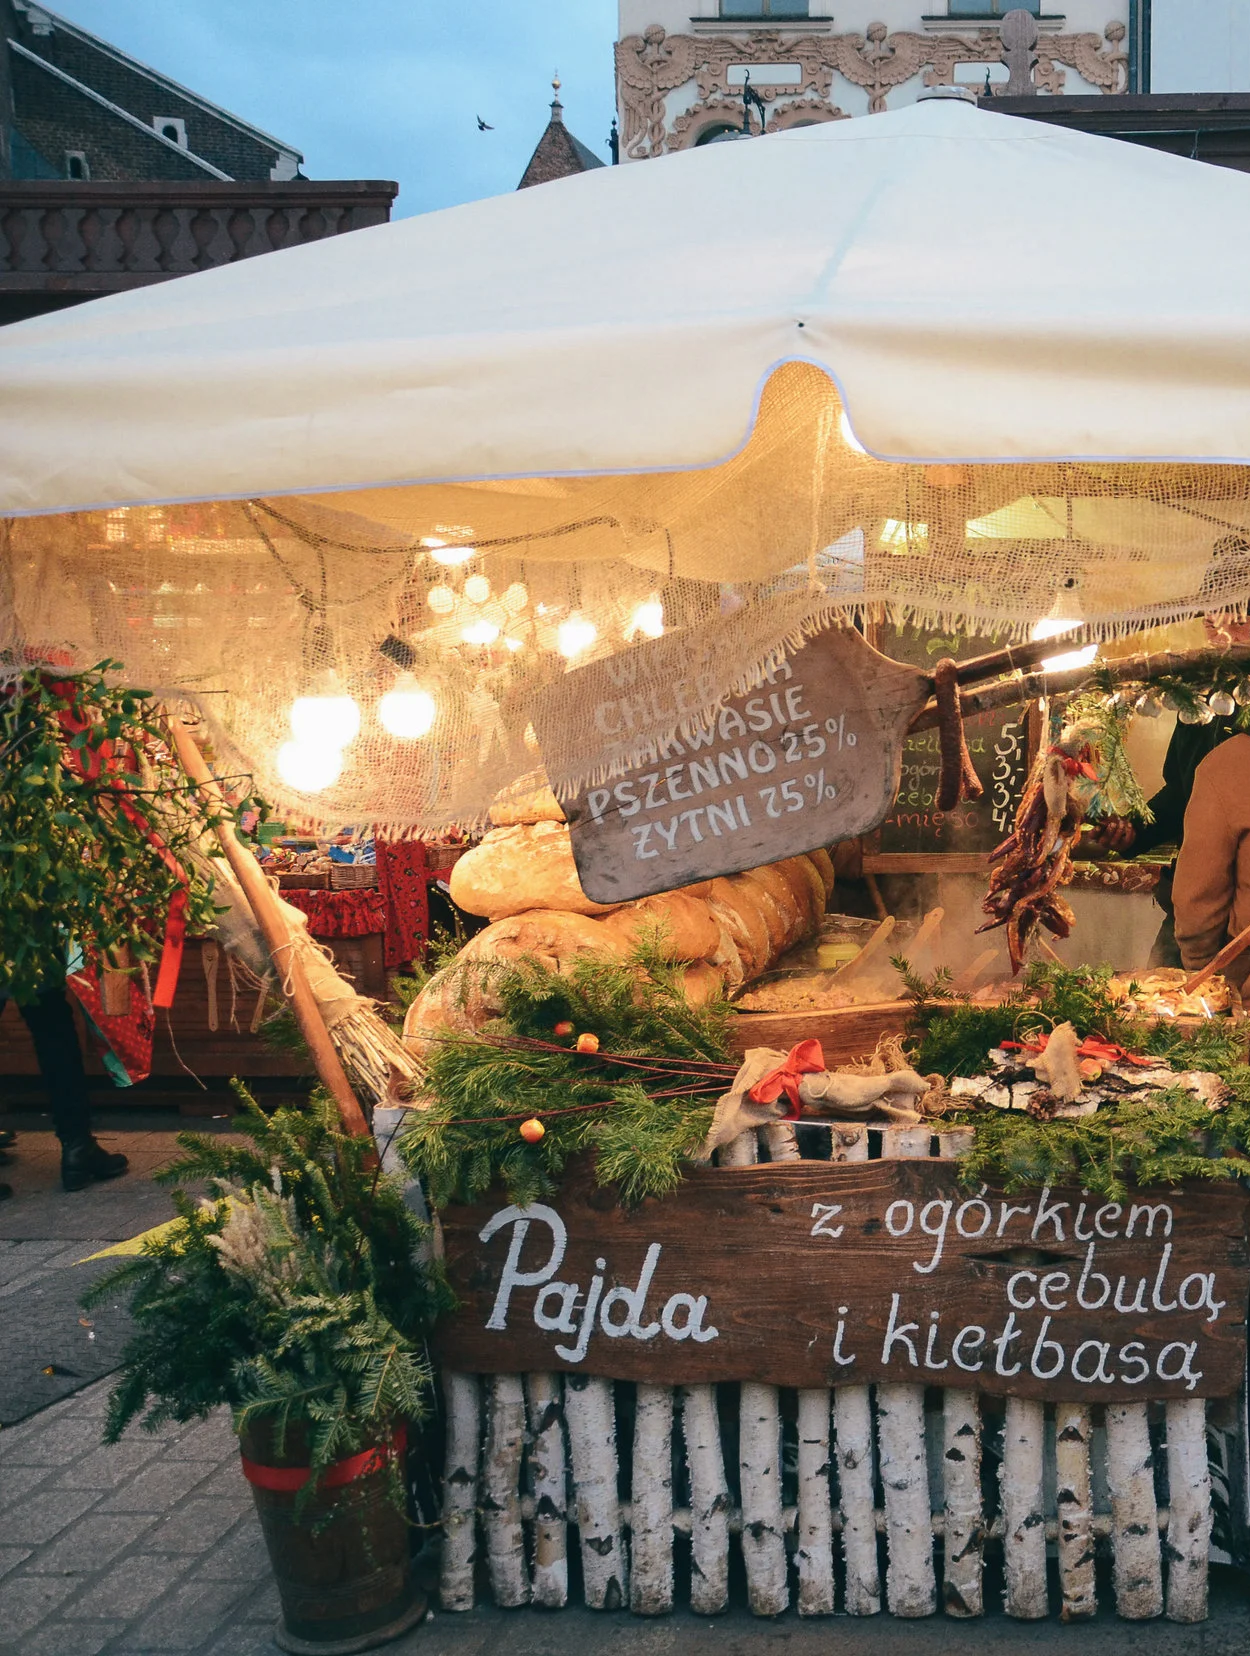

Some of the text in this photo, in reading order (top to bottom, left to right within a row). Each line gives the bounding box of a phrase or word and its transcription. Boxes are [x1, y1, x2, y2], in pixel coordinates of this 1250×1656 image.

[587, 713, 857, 826] PSZENNO 25%
[758, 767, 837, 819] 75%
[810, 1184, 1173, 1274] z ogórkiem
[478, 1202, 719, 1363] Pajda
[1007, 1242, 1226, 1323] cebulą
[833, 1292, 1203, 1391] i kiełbasą
